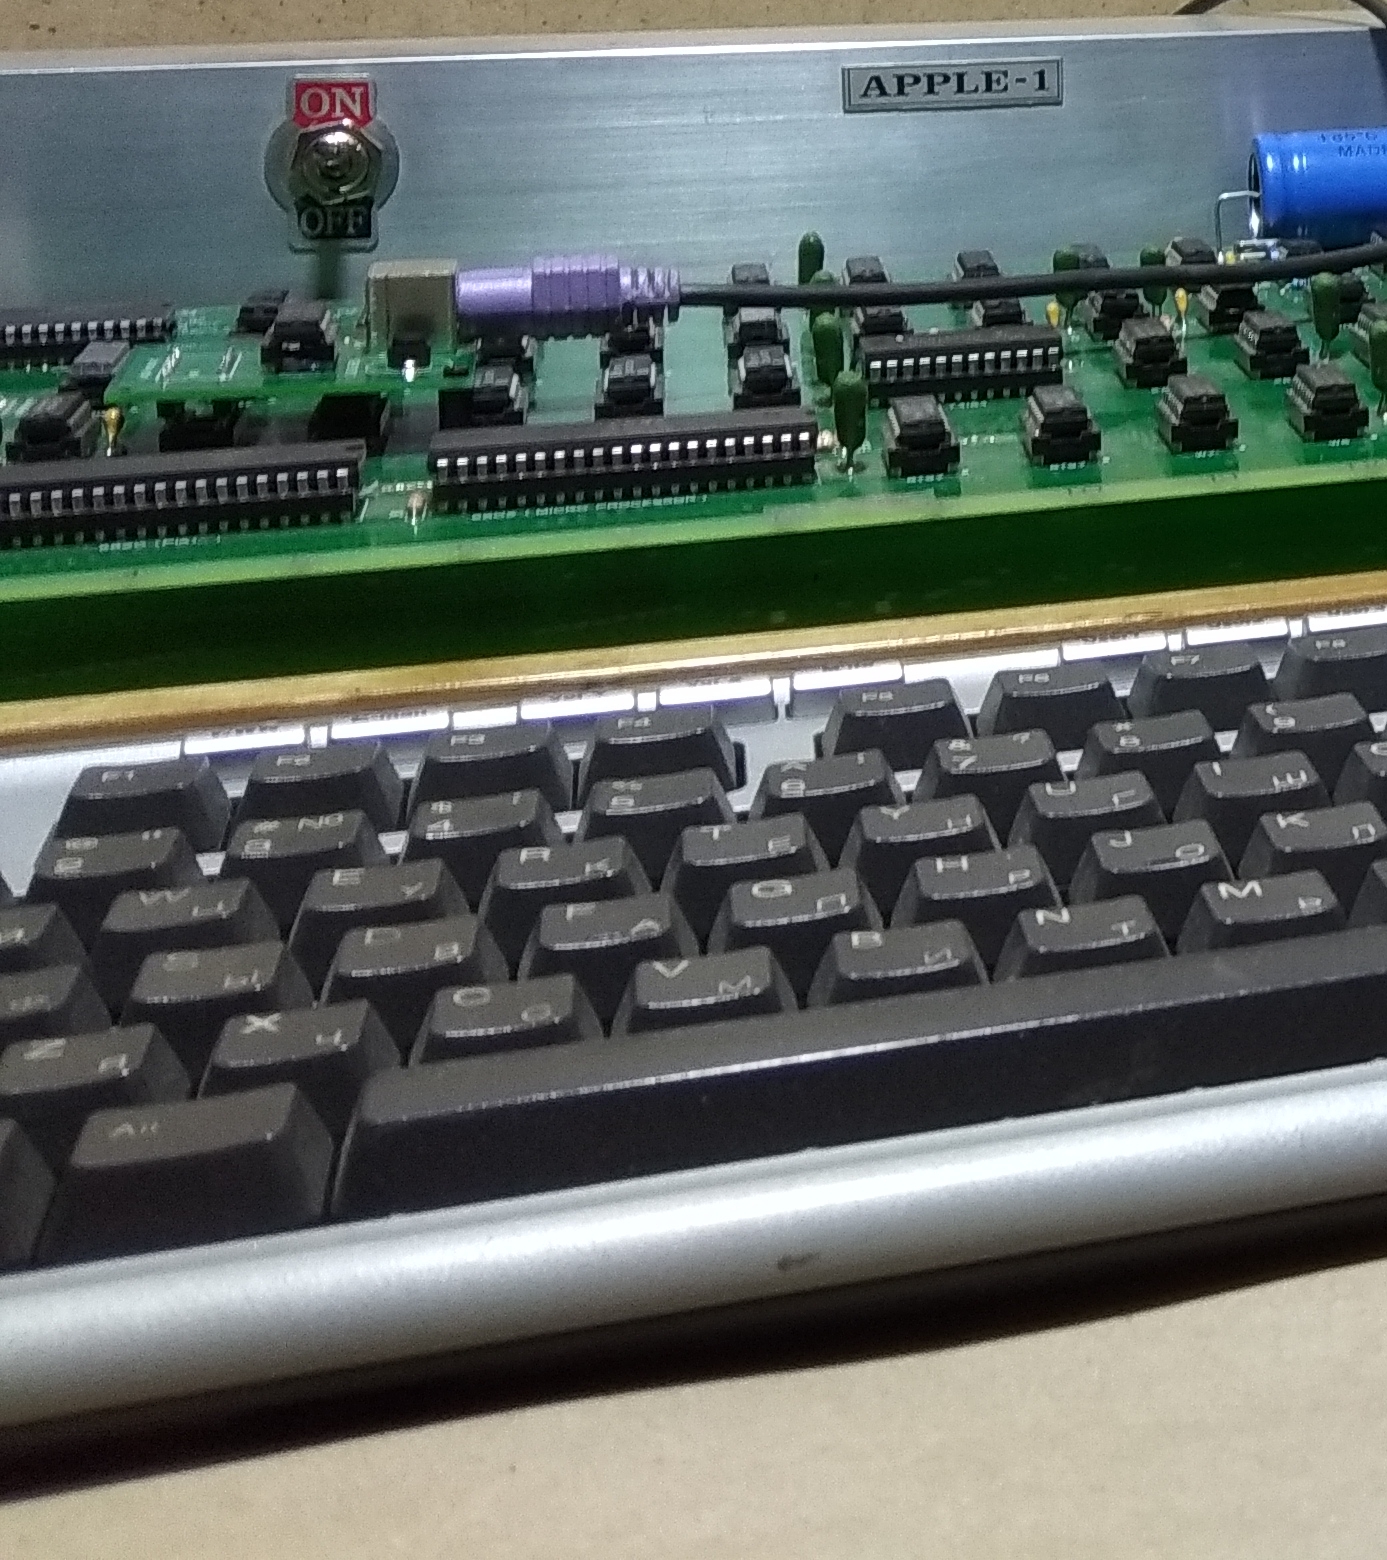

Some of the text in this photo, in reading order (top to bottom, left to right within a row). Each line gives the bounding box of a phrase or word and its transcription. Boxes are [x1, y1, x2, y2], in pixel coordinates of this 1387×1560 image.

[860, 67, 1053, 99] APPLE-1
[299, 85, 365, 121] ON
[300, 205, 364, 235] OFF
[653, 959, 690, 979] V
[240, 1013, 282, 1035] X
